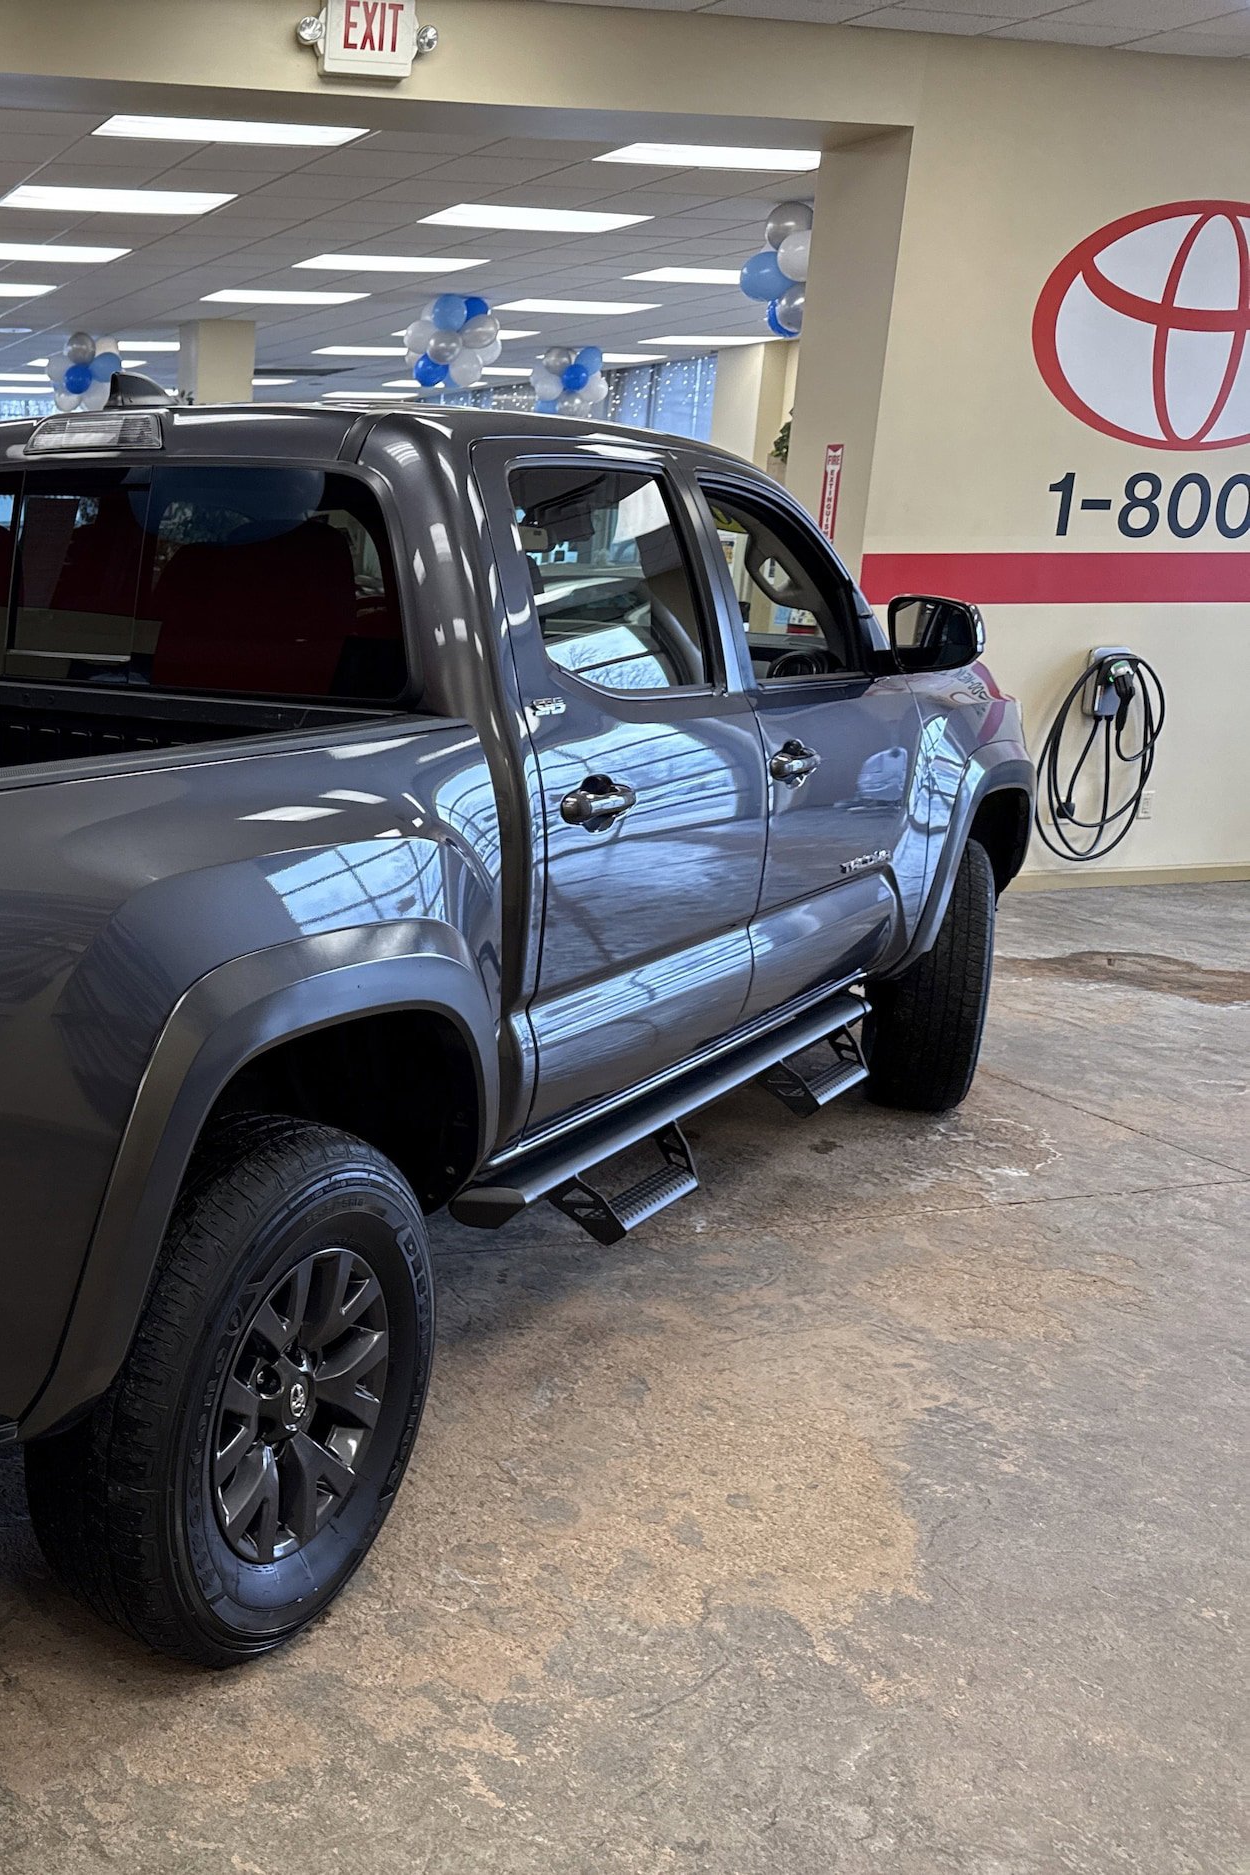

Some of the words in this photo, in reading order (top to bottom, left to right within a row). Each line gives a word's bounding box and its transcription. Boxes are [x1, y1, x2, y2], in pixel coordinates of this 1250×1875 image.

[343, 0, 405, 53] EXIT
[828, 454, 840, 466] FIRE
[823, 469, 835, 537] EXTINGUISH
